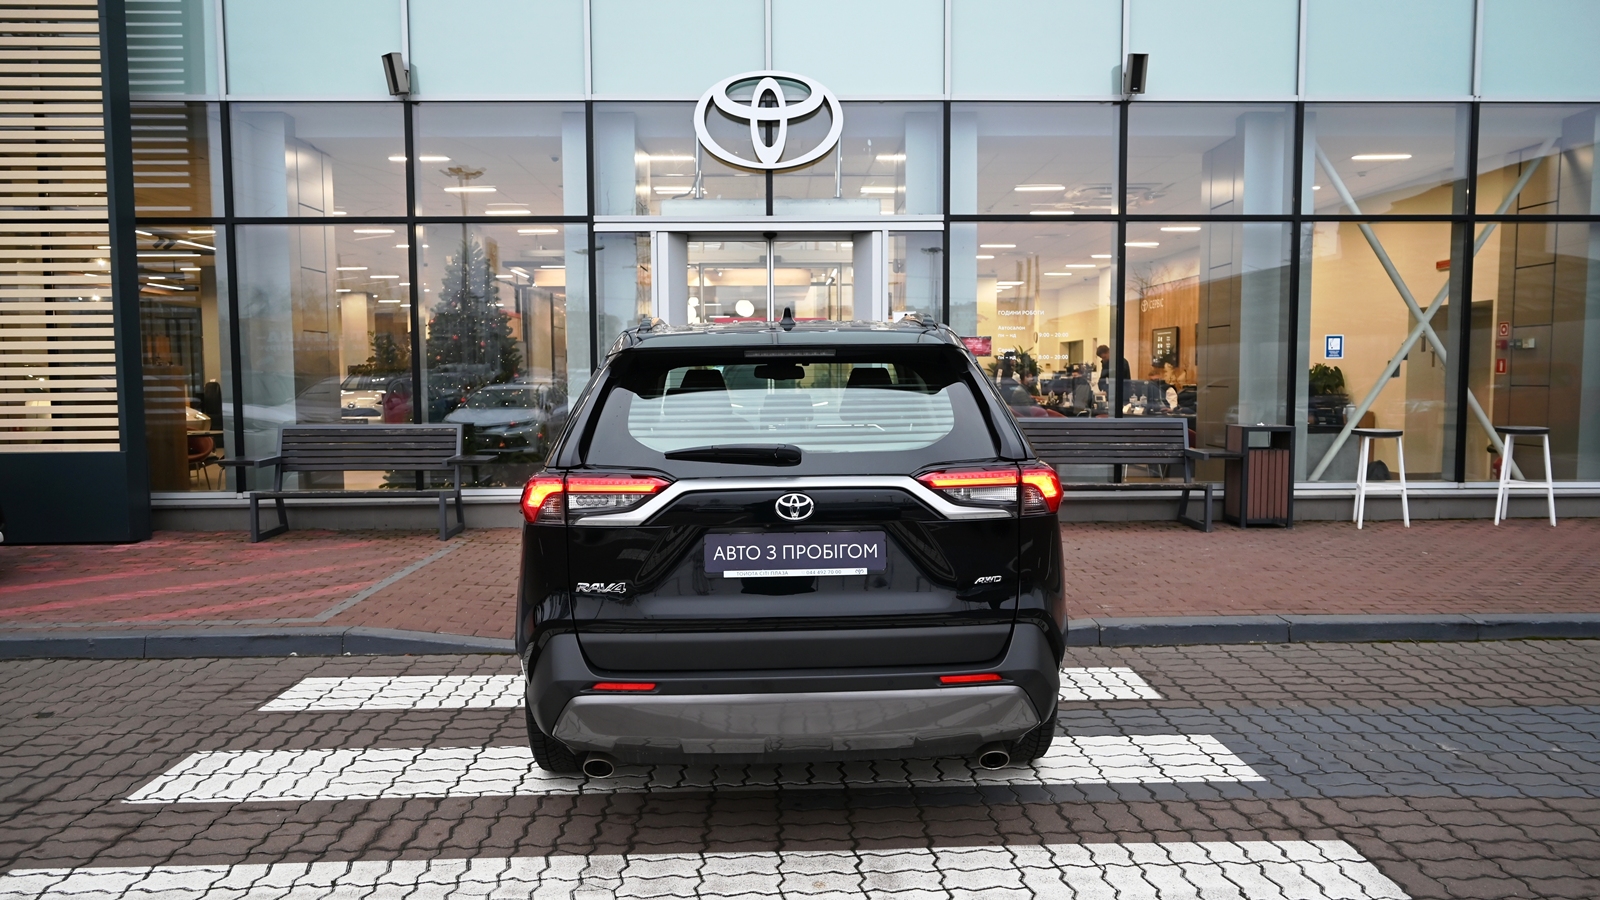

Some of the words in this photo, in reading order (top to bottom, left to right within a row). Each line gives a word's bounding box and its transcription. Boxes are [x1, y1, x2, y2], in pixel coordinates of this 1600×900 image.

[713, 545, 761, 561] АВТО
[766, 545, 777, 560] З
[783, 543, 878, 560] ПРОБІГОМ
[974, 575, 1002, 584] AWD
[575, 582, 627, 594] RAV4
